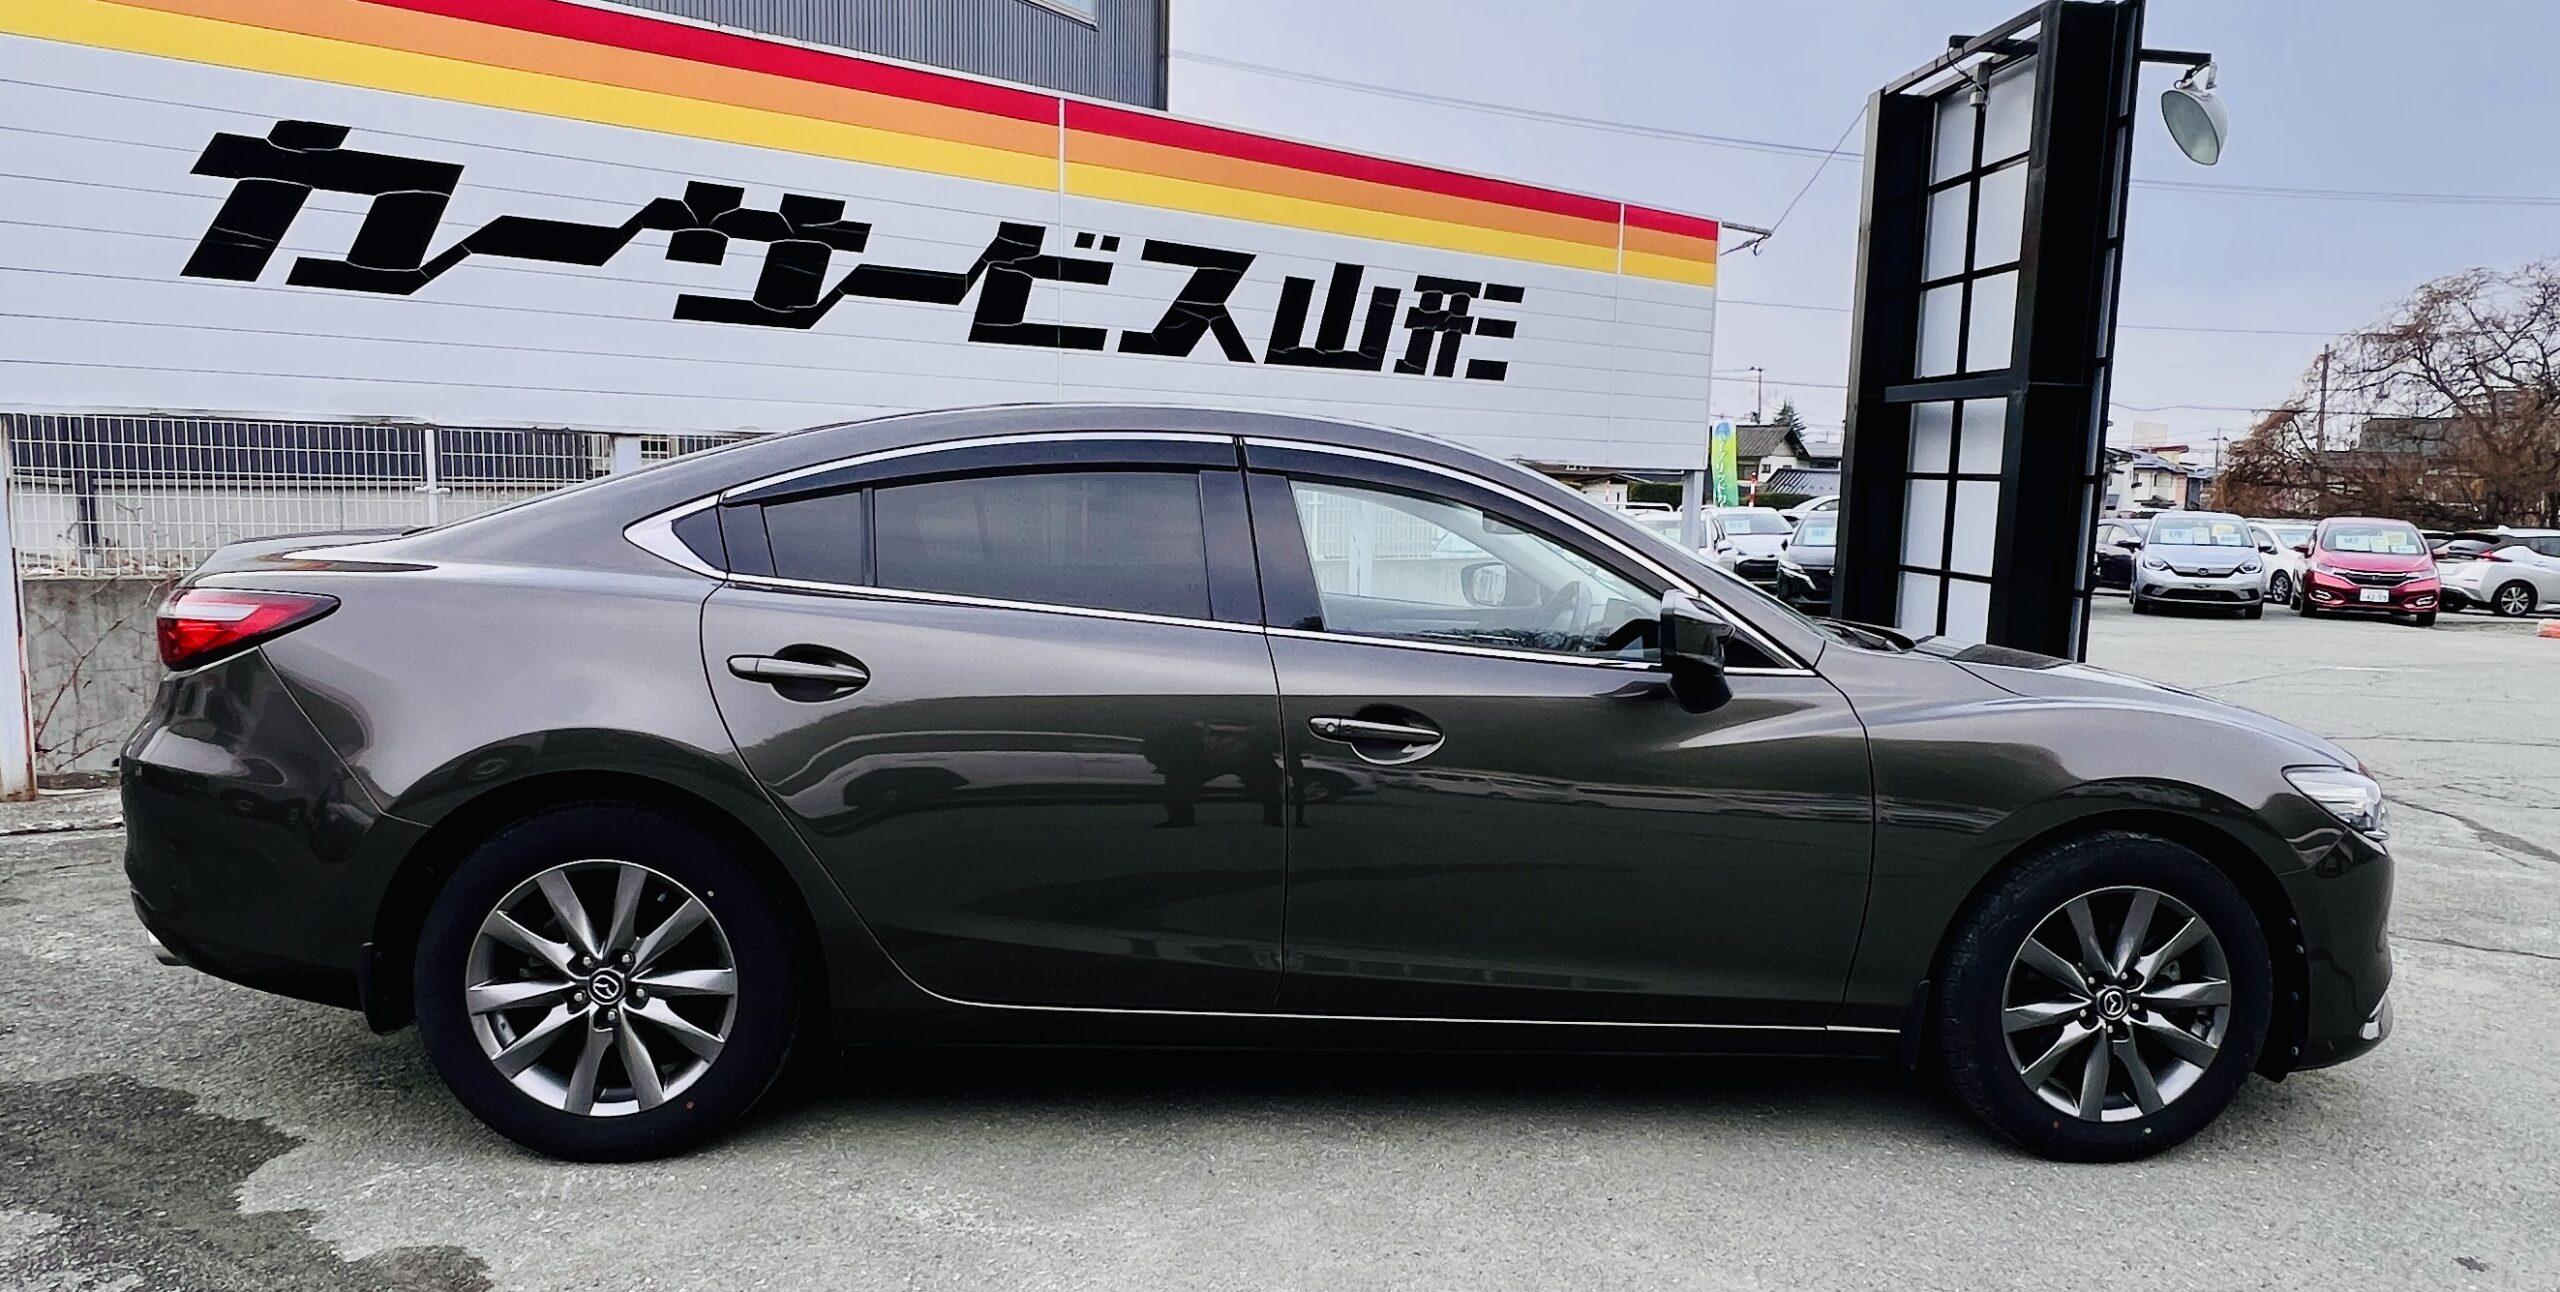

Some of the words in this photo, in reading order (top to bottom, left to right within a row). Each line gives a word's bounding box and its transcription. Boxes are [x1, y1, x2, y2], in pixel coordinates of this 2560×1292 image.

[180, 120, 1525, 382] カーサービス山形
